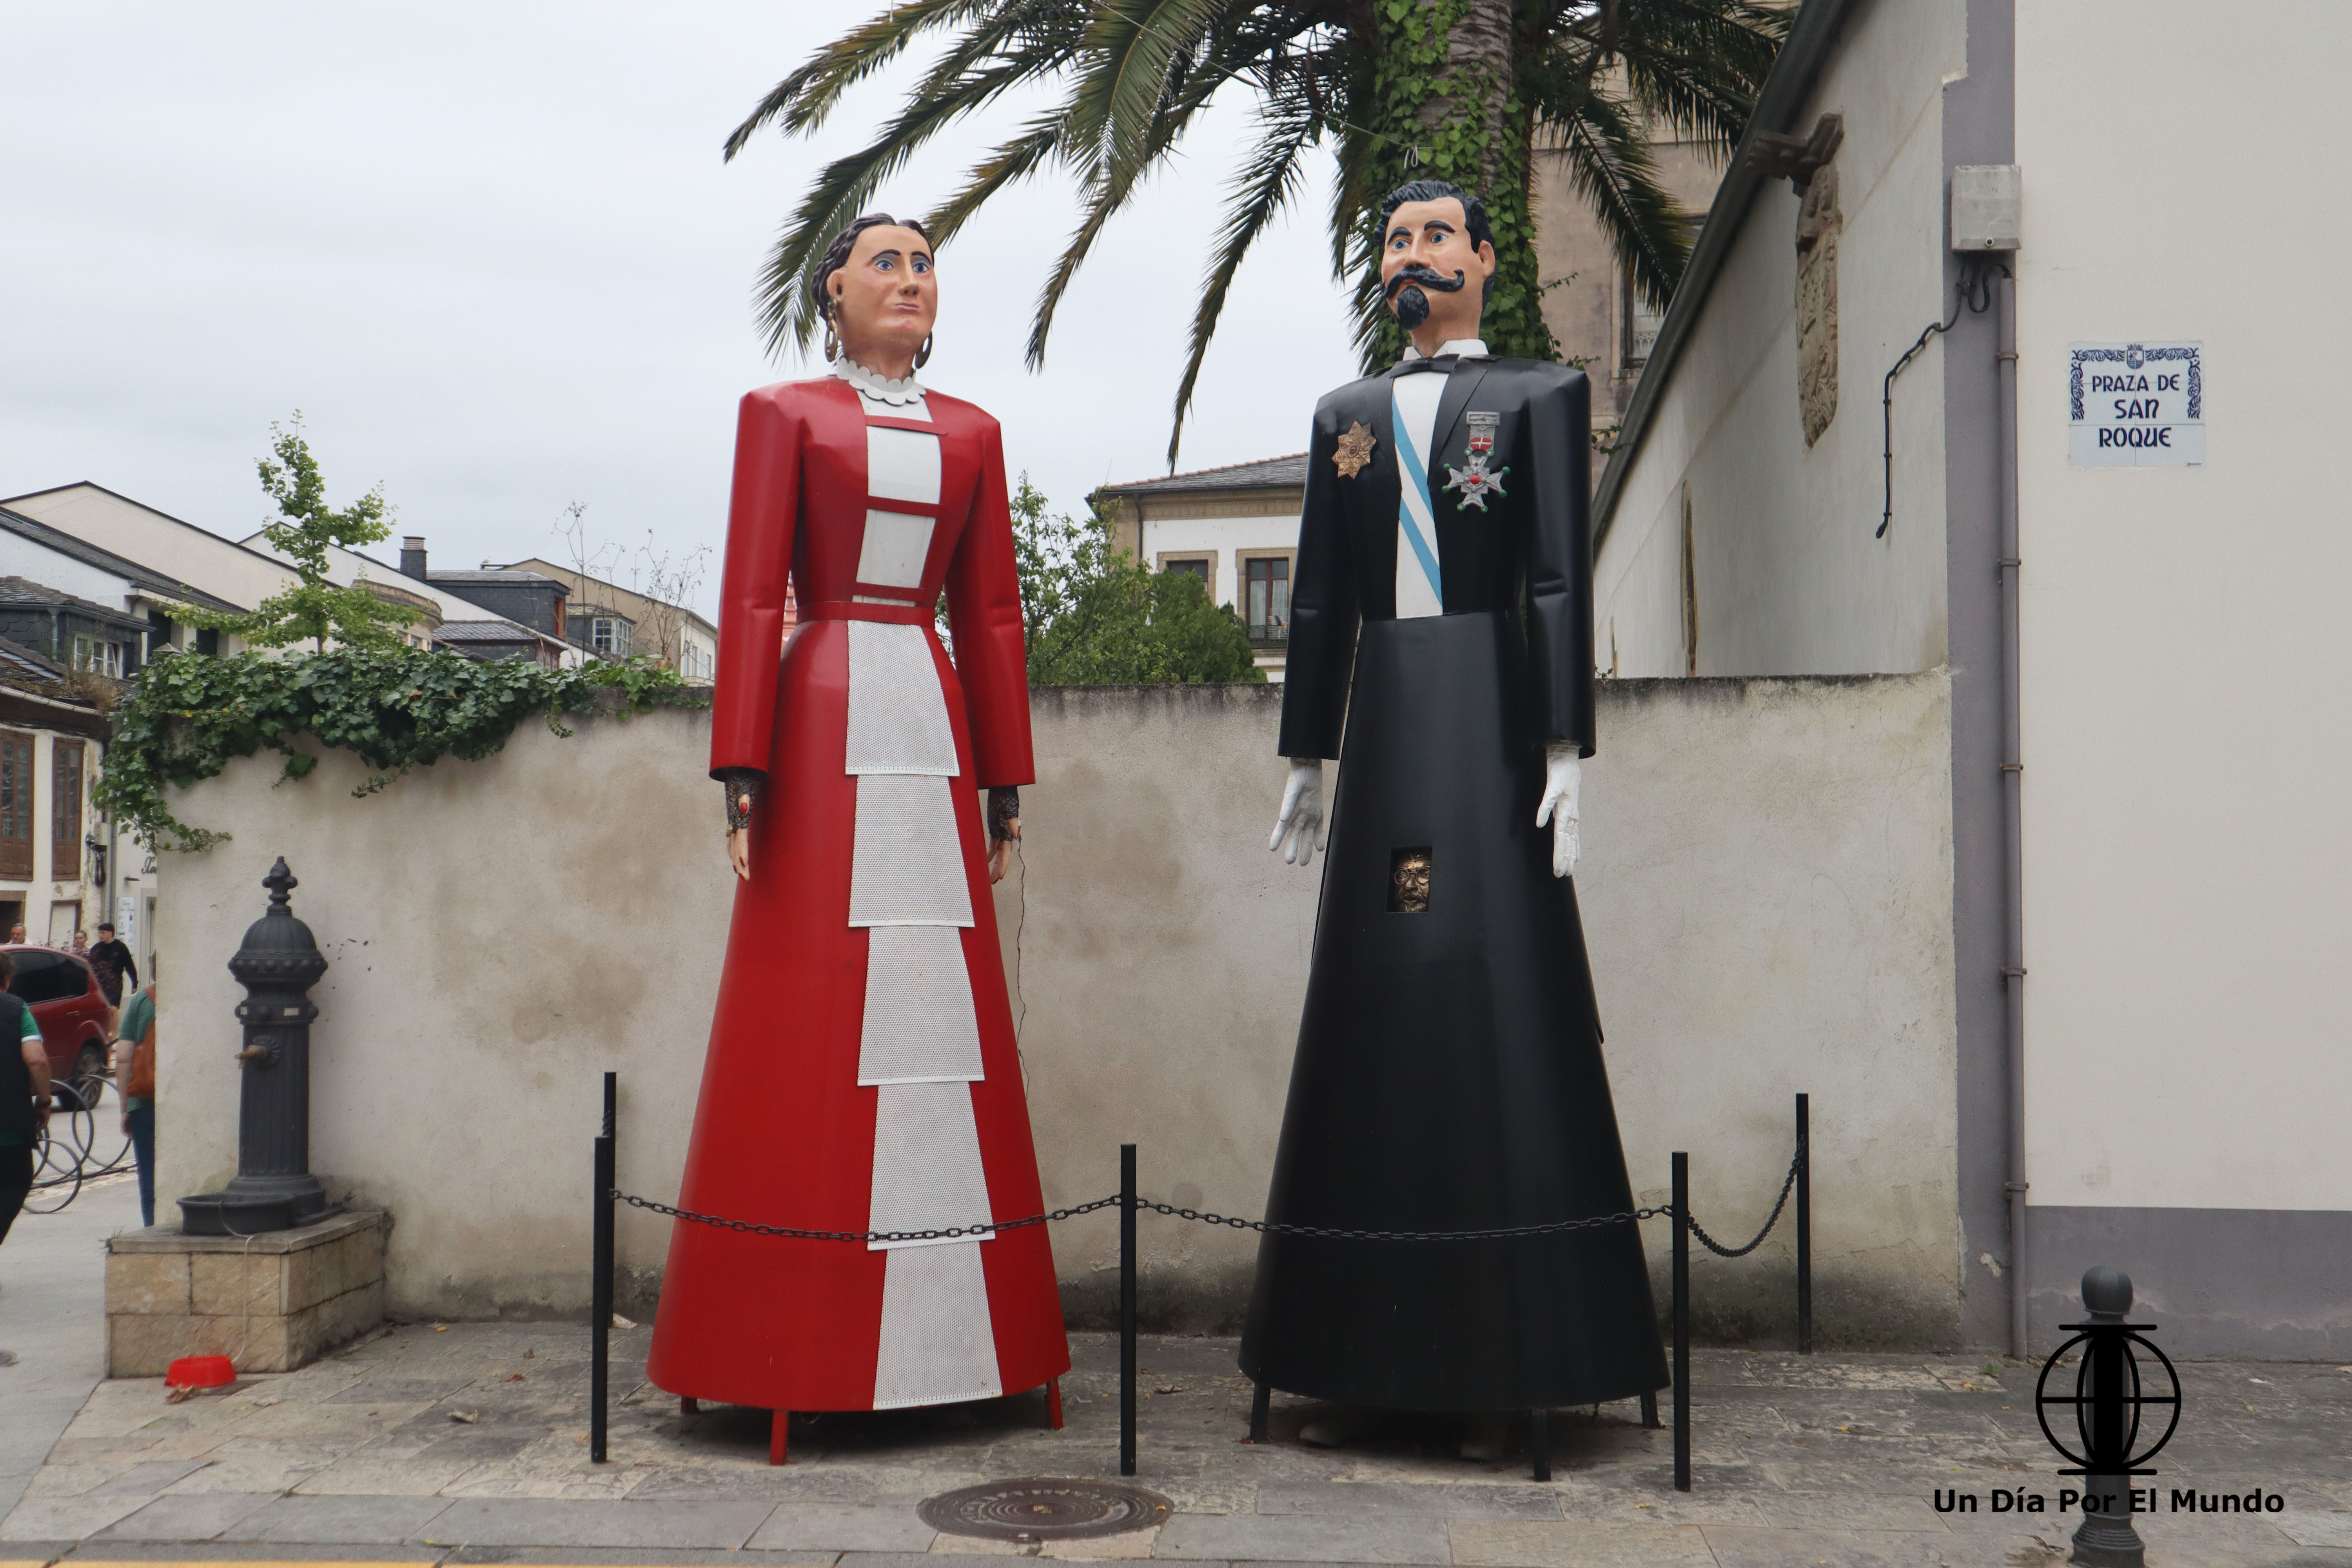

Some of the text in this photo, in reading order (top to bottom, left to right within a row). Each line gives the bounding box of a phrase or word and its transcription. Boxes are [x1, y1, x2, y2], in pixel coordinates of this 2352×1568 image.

[2092, 374, 2180, 392] PRAZA DE
[2114, 398, 2160, 419] SAN
[2098, 427, 2172, 447] ROQUE
